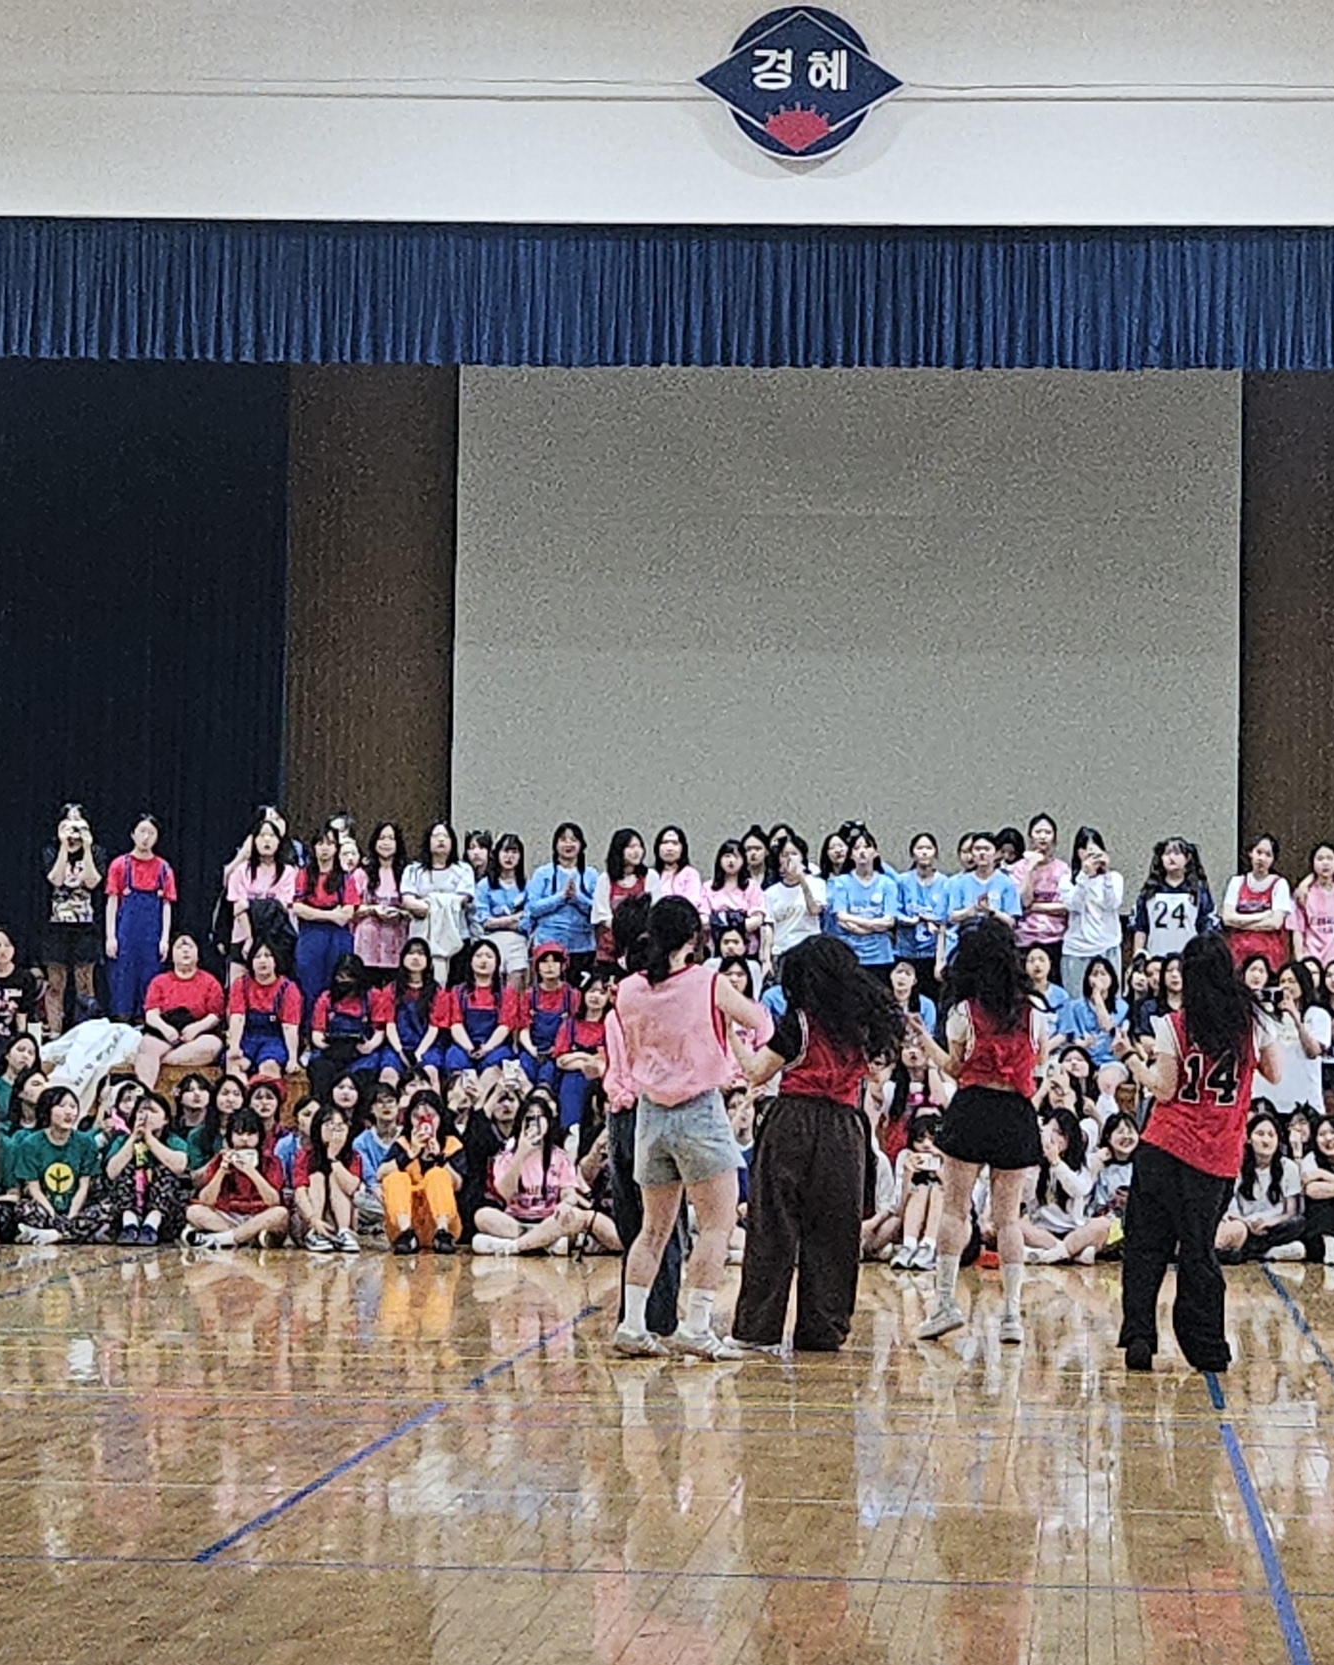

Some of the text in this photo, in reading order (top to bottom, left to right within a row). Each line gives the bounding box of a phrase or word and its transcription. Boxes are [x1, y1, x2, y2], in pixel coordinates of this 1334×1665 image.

[751, 48, 849, 91] 경혜
[1154, 901, 1186, 929] 24
[1178, 1050, 1240, 1107] 14
